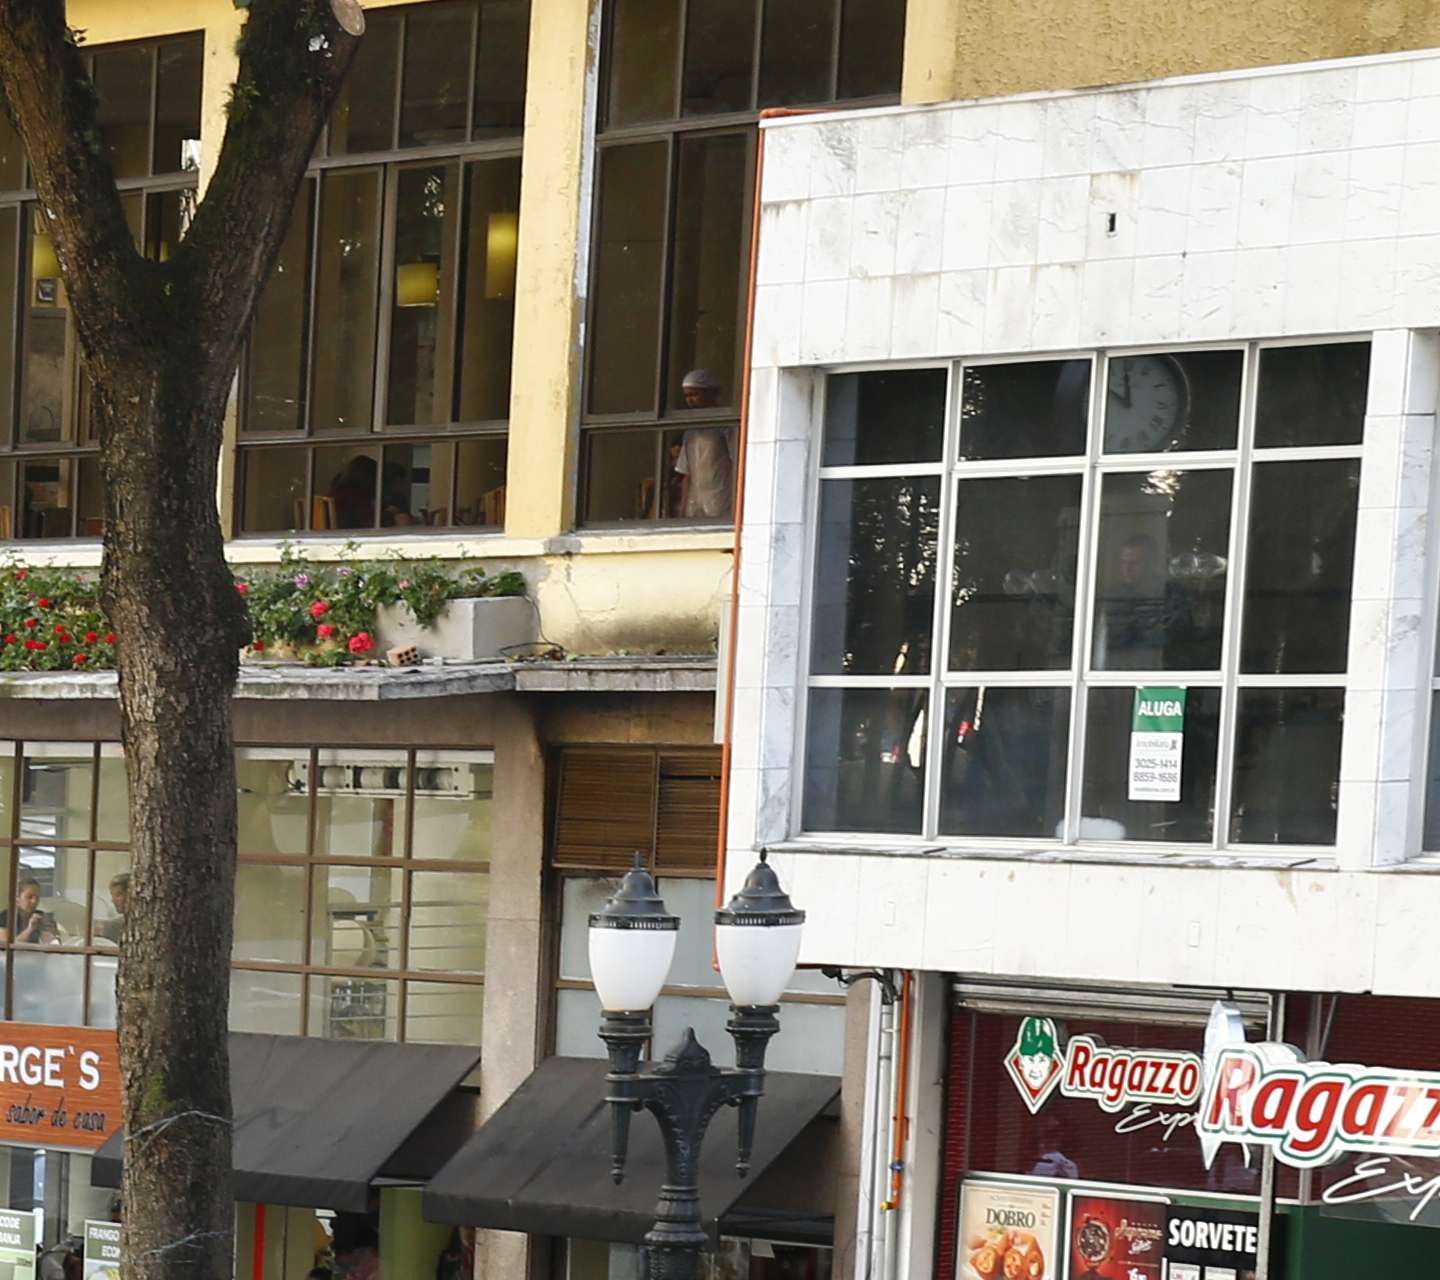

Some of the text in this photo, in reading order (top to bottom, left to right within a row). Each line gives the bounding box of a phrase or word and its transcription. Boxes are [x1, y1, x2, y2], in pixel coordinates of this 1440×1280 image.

[1138, 700, 1183, 716] ALUGA
[1067, 1045, 1199, 1103] Ragazzo
[6, 1093, 105, 1132] sabor de casa
[986, 1208, 1036, 1229] DOBRO
[1168, 1218, 1258, 1254] SORVETE
